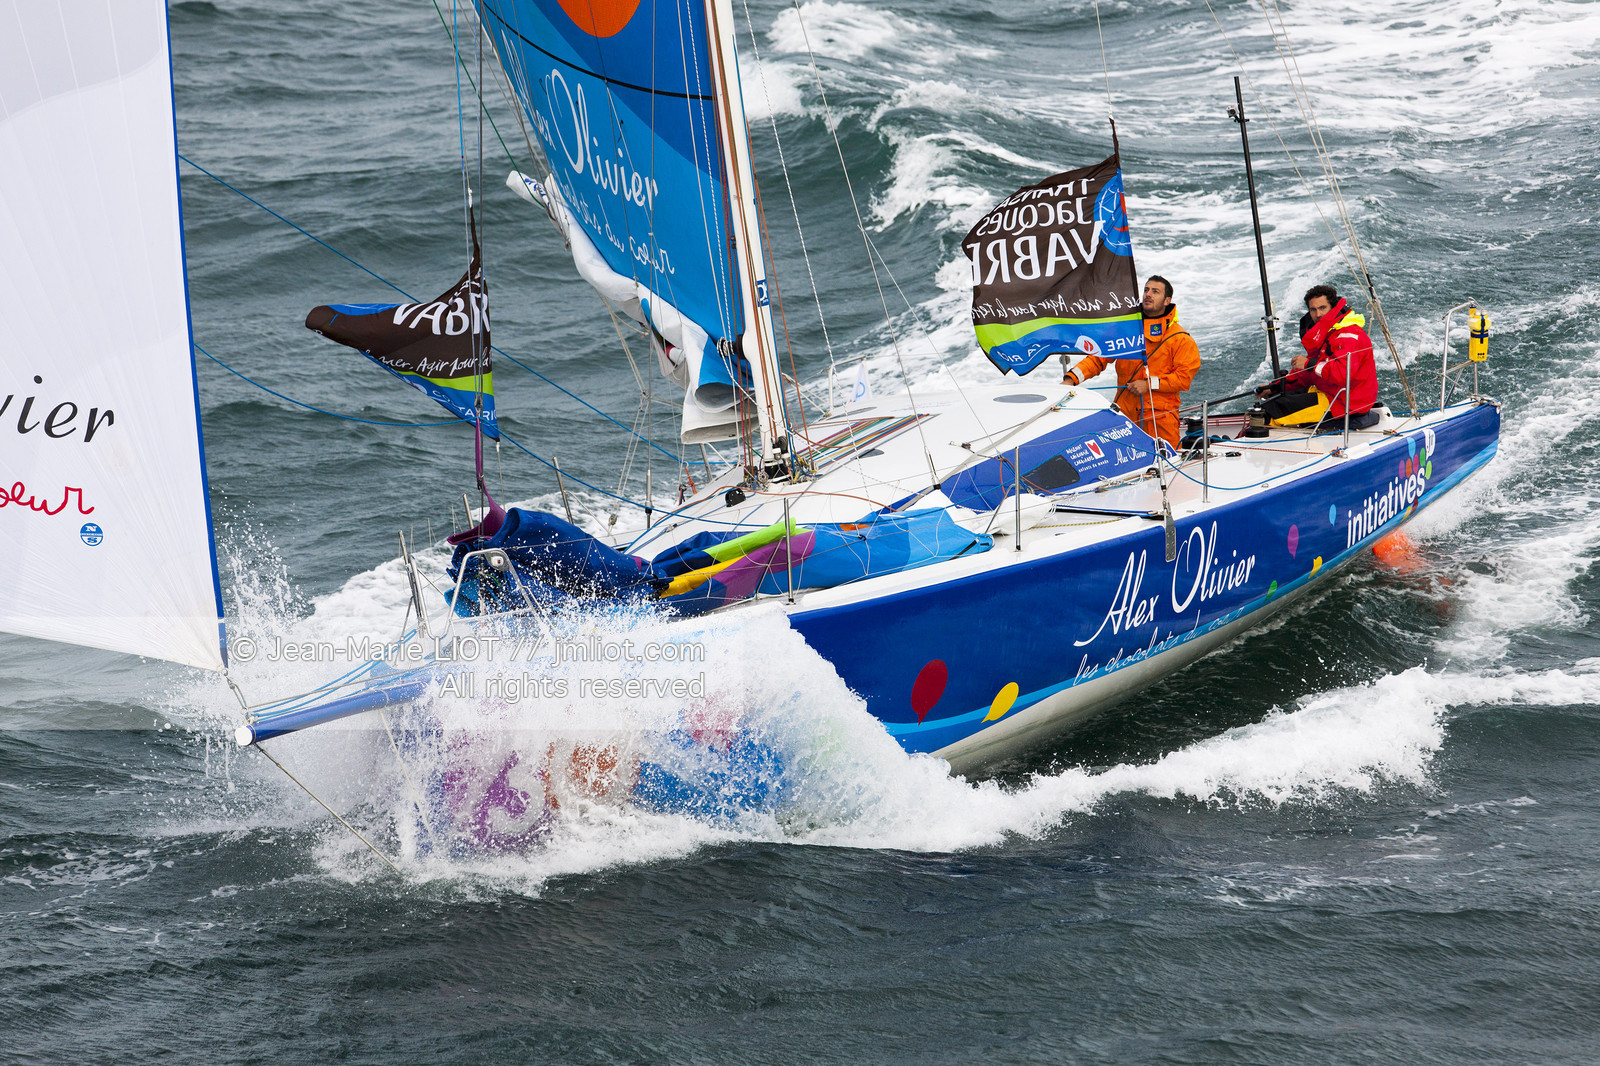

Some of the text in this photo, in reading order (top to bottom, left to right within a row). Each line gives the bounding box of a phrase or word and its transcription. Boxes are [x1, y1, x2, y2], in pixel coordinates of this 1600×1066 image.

[545, 68, 659, 211] Olivier
[1347, 467, 1426, 549] initiatives
[1073, 520, 1256, 647] Alex Olivier
